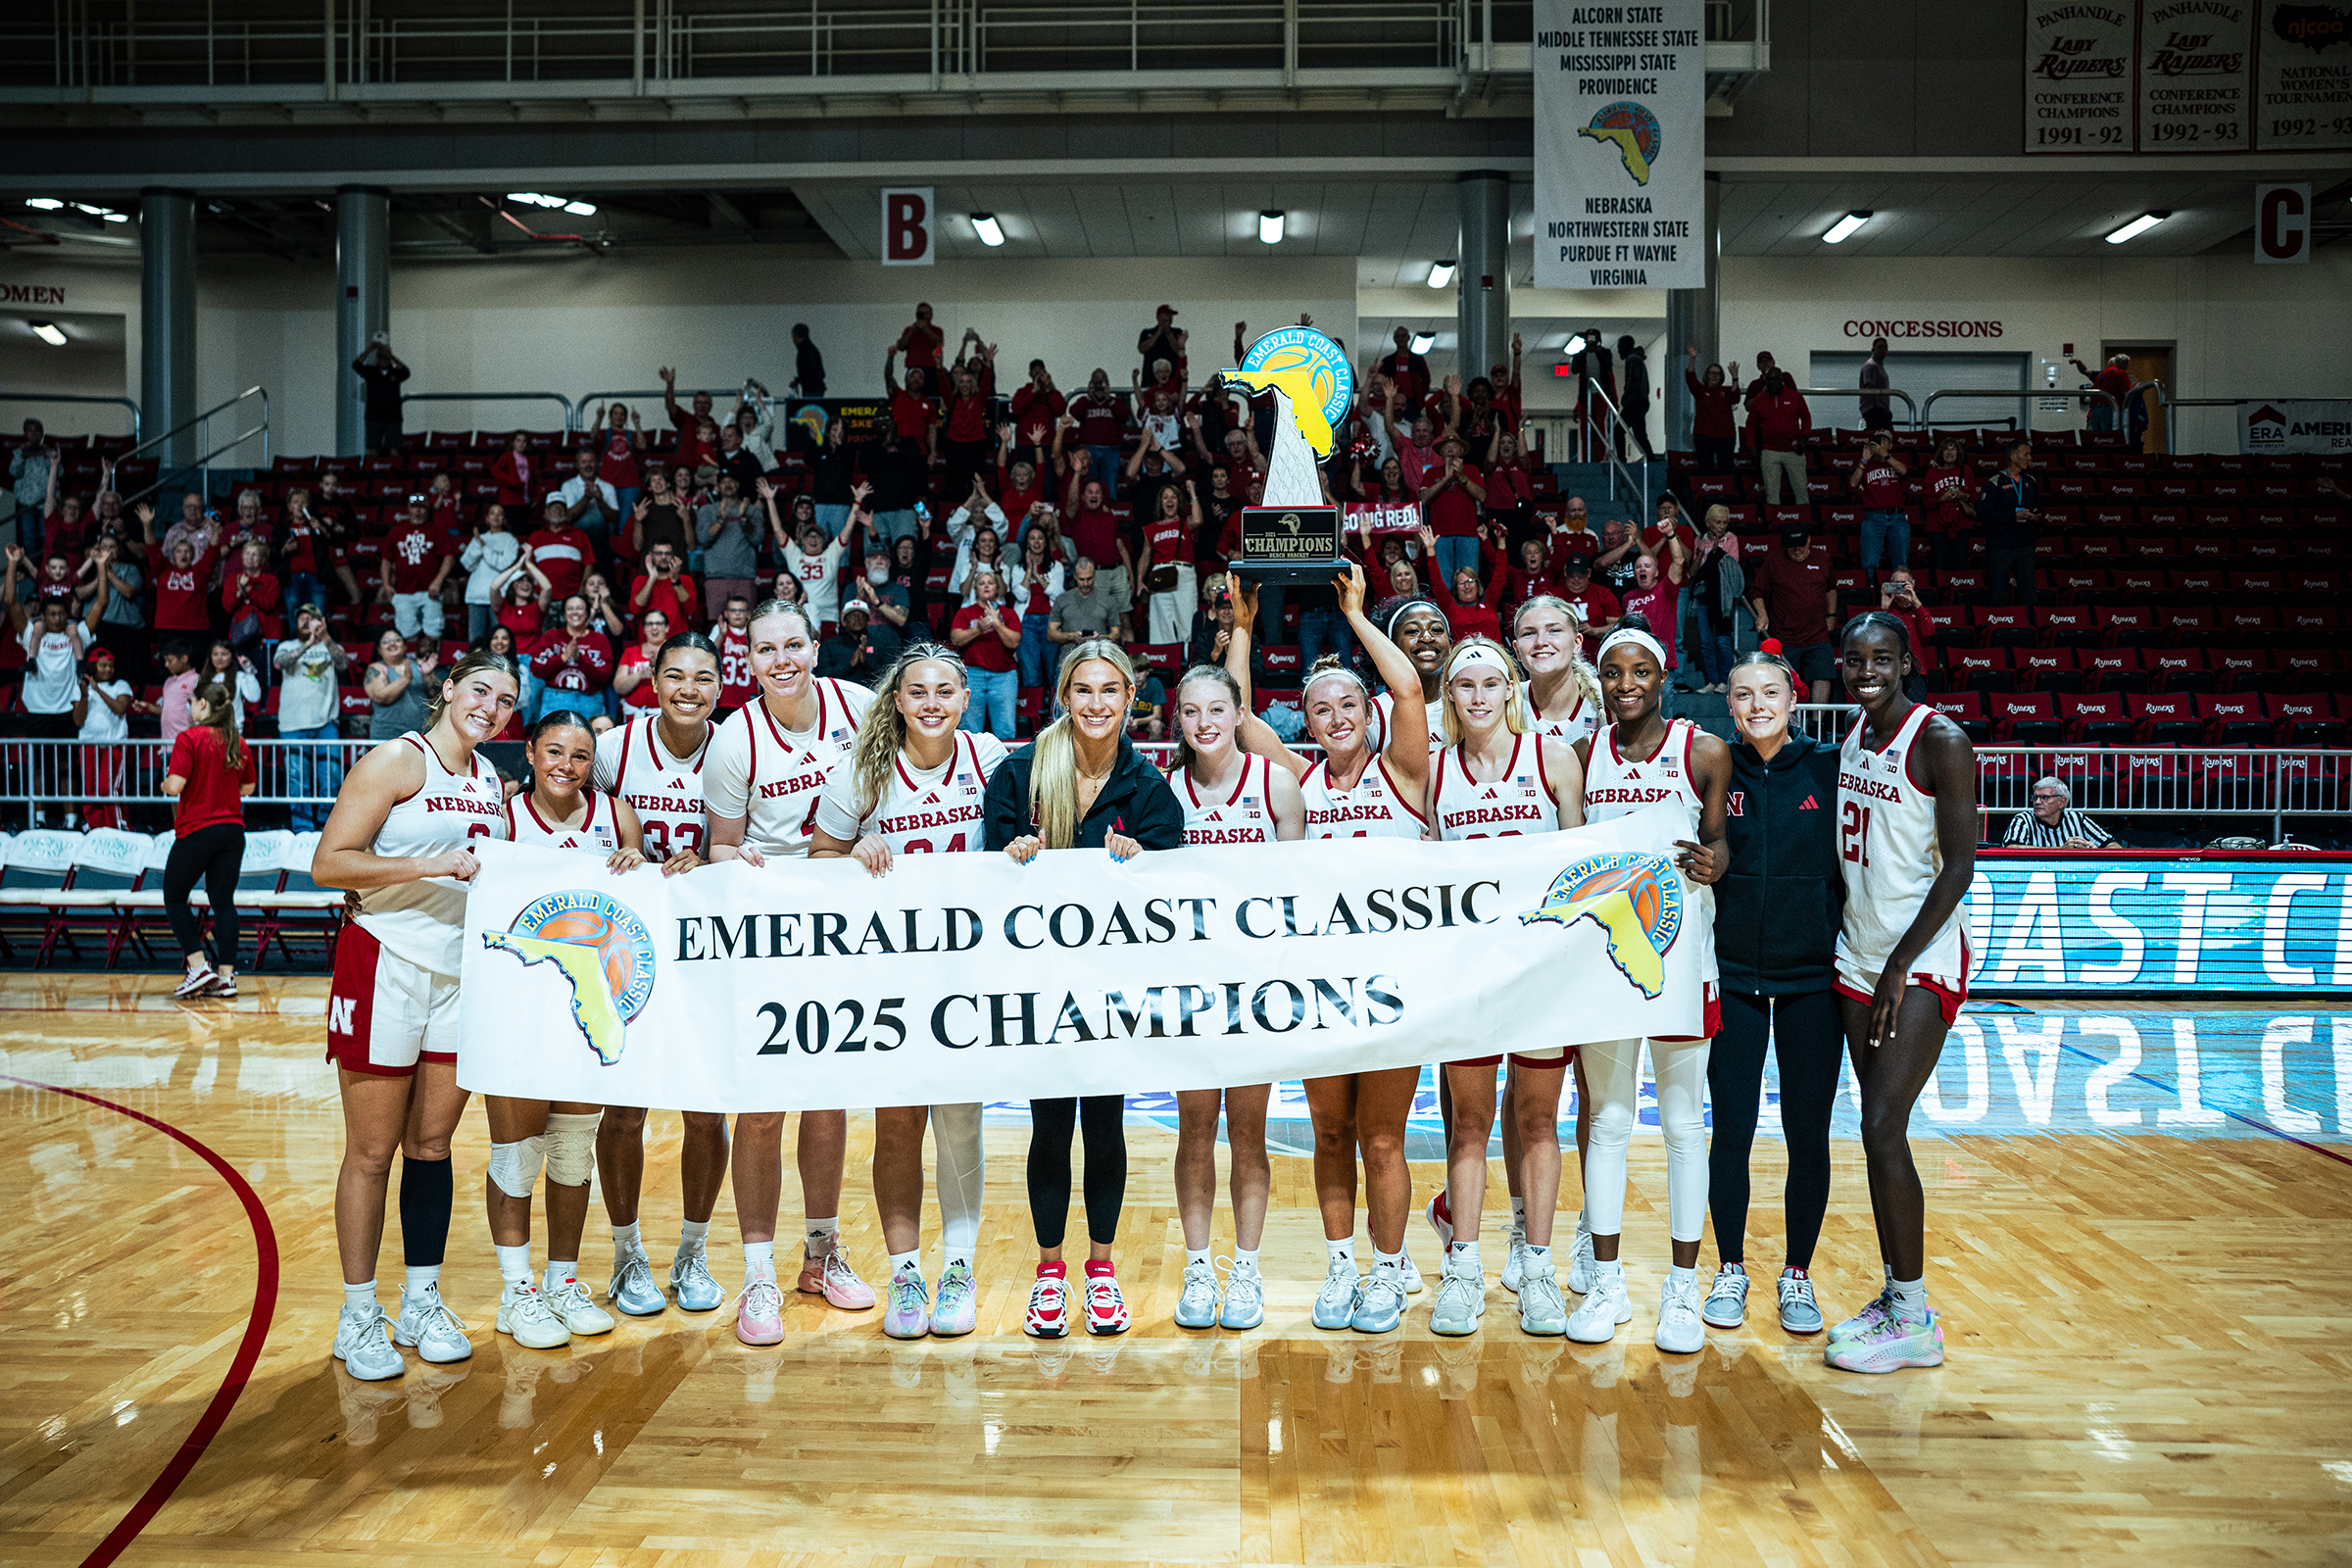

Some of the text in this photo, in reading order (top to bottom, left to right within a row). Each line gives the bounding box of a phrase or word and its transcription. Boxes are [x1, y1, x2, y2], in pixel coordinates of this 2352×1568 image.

[1572, 7, 1663, 24] ALCORN STATE
[2036, 6, 2126, 28] PANHANDLE
[2152, 2, 2242, 24] PANHANDLE
[2287, 18, 2343, 39] njcaa
[1538, 30, 1698, 47] MIDDLE TENNESSEE STATE
[2050, 36, 2098, 55] LADY
[2165, 32, 2214, 51] LADY
[1560, 54, 1676, 71] MISSISSIPPI STATE
[2281, 66, 2350, 78] NATIONAL
[1579, 78, 1657, 94] PROVIDENCE
[2280, 78, 2350, 91] WOMEN'S
[2034, 92, 2125, 104] CONFERENCE
[2149, 88, 2240, 101] CONFERENCE
[2037, 108, 2119, 119] CHAMPIONS
[2152, 104, 2235, 115] CHAMPIONS
[1586, 197, 1652, 214] NEBRASKA
[888, 194, 927, 260] B
[1548, 220, 1689, 237] NORTHWESTERN STATE
[2261, 188, 2303, 259] C
[1560, 245, 1677, 262] PURDUE FT WAYNE
[1591, 270, 1647, 285] VIRGINIA
[1843, 320, 2003, 337] CONCESSIONS
[1248, 331, 1348, 419] EMERALD COAST CLASSIC
[2250, 428, 2283, 439] ERA
[2290, 422, 2352, 436] AMERI
[1386, 508, 1418, 526] RED!
[1246, 537, 1333, 552] CHAMPIONS
[801, 565, 824, 581] 33
[722, 656, 751, 687] 33
[759, 765, 835, 799] NEBRA
[1585, 788, 1685, 808] NEBRASK
[878, 804, 984, 835] NEBRASKA
[1305, 805, 1393, 824] EBRASKA
[1443, 805, 1542, 830] NEBRASKA
[643, 819, 705, 863] 33
[1179, 828, 1265, 845] EBRASKA
[1842, 800, 1871, 868] 21
[1551, 855, 1680, 945] EMERALD COAST CLASSIC
[673, 879, 1502, 961] EMERALD COAST CLASSIC
[520, 892, 652, 1014] EMERALD COAST CLASSIC
[329, 994, 357, 1036] N
[756, 973, 1405, 1054] 2025 CHAMPIONS
[1794, 1269, 1804, 1279] N
